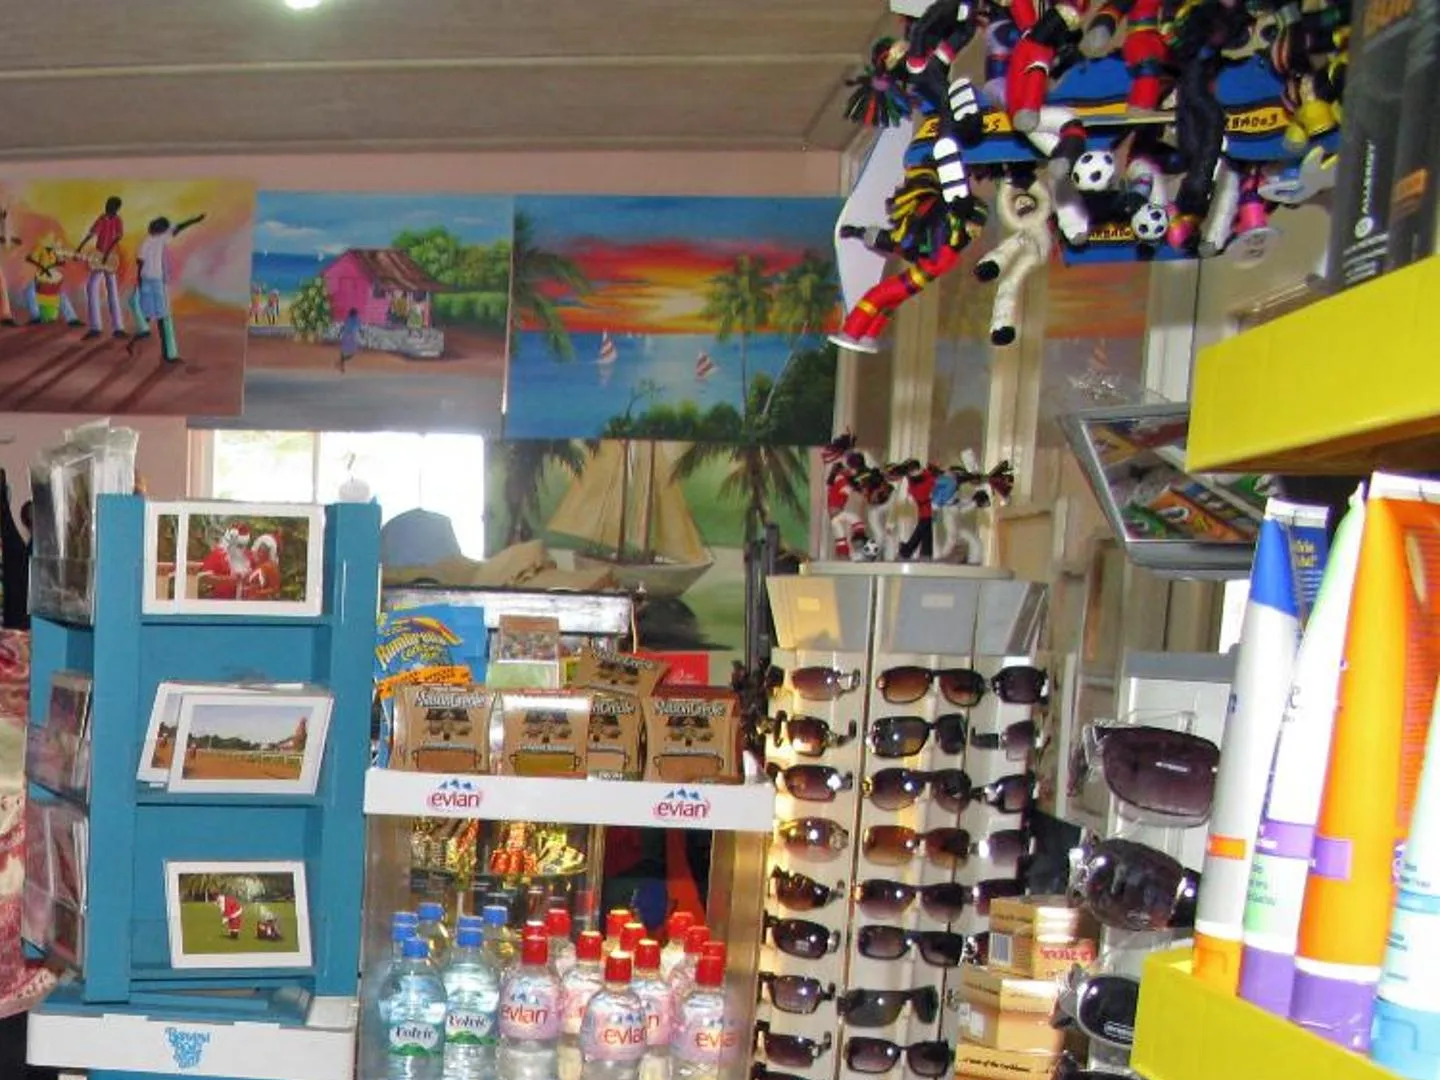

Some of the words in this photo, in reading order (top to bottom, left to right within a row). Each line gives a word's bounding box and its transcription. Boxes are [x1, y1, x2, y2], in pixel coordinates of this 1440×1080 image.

[430, 788, 480, 809] evian
[657, 799, 709, 820] evian
[501, 1003, 548, 1027] evian
[695, 1030, 739, 1048] evia
